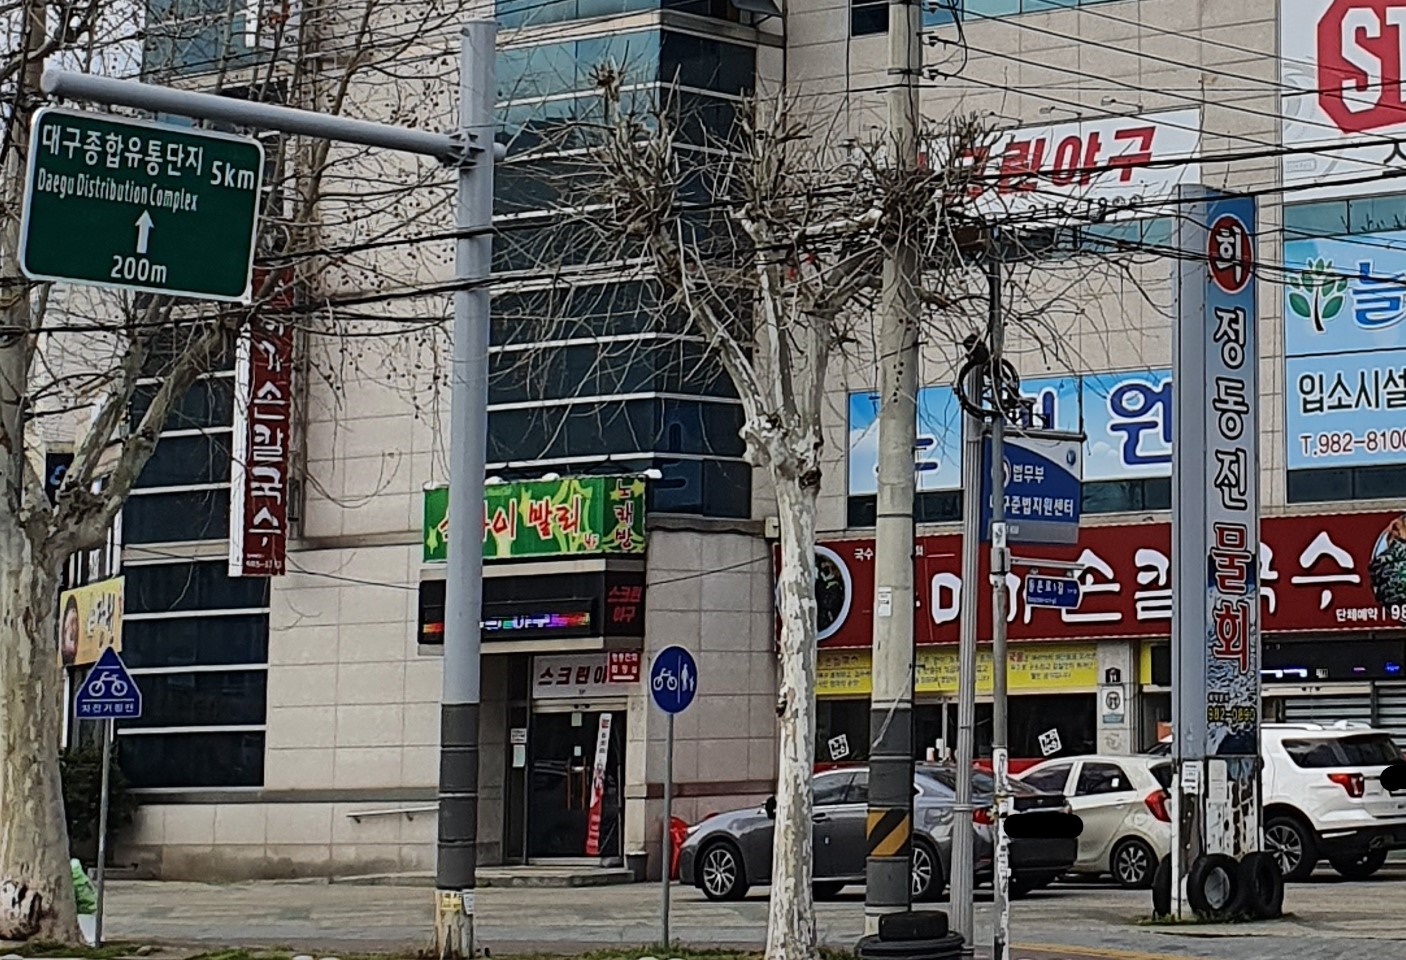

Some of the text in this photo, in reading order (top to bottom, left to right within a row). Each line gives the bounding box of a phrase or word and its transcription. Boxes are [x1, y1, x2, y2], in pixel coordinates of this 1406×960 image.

[42, 124, 255, 190] 대구종합유통단지 5km
[38, 168, 199, 213] Daegu Distribution Complex
[111, 255, 168, 283] 200m
[1214, 225, 1243, 285] 회
[1213, 305, 1249, 513] 정동진
[1013, 464, 1044, 484] 법무부
[990, 495, 1074, 518] 구준법지원센터
[1210, 522, 1252, 677] 물회
[537, 665, 608, 686] 스크린야
